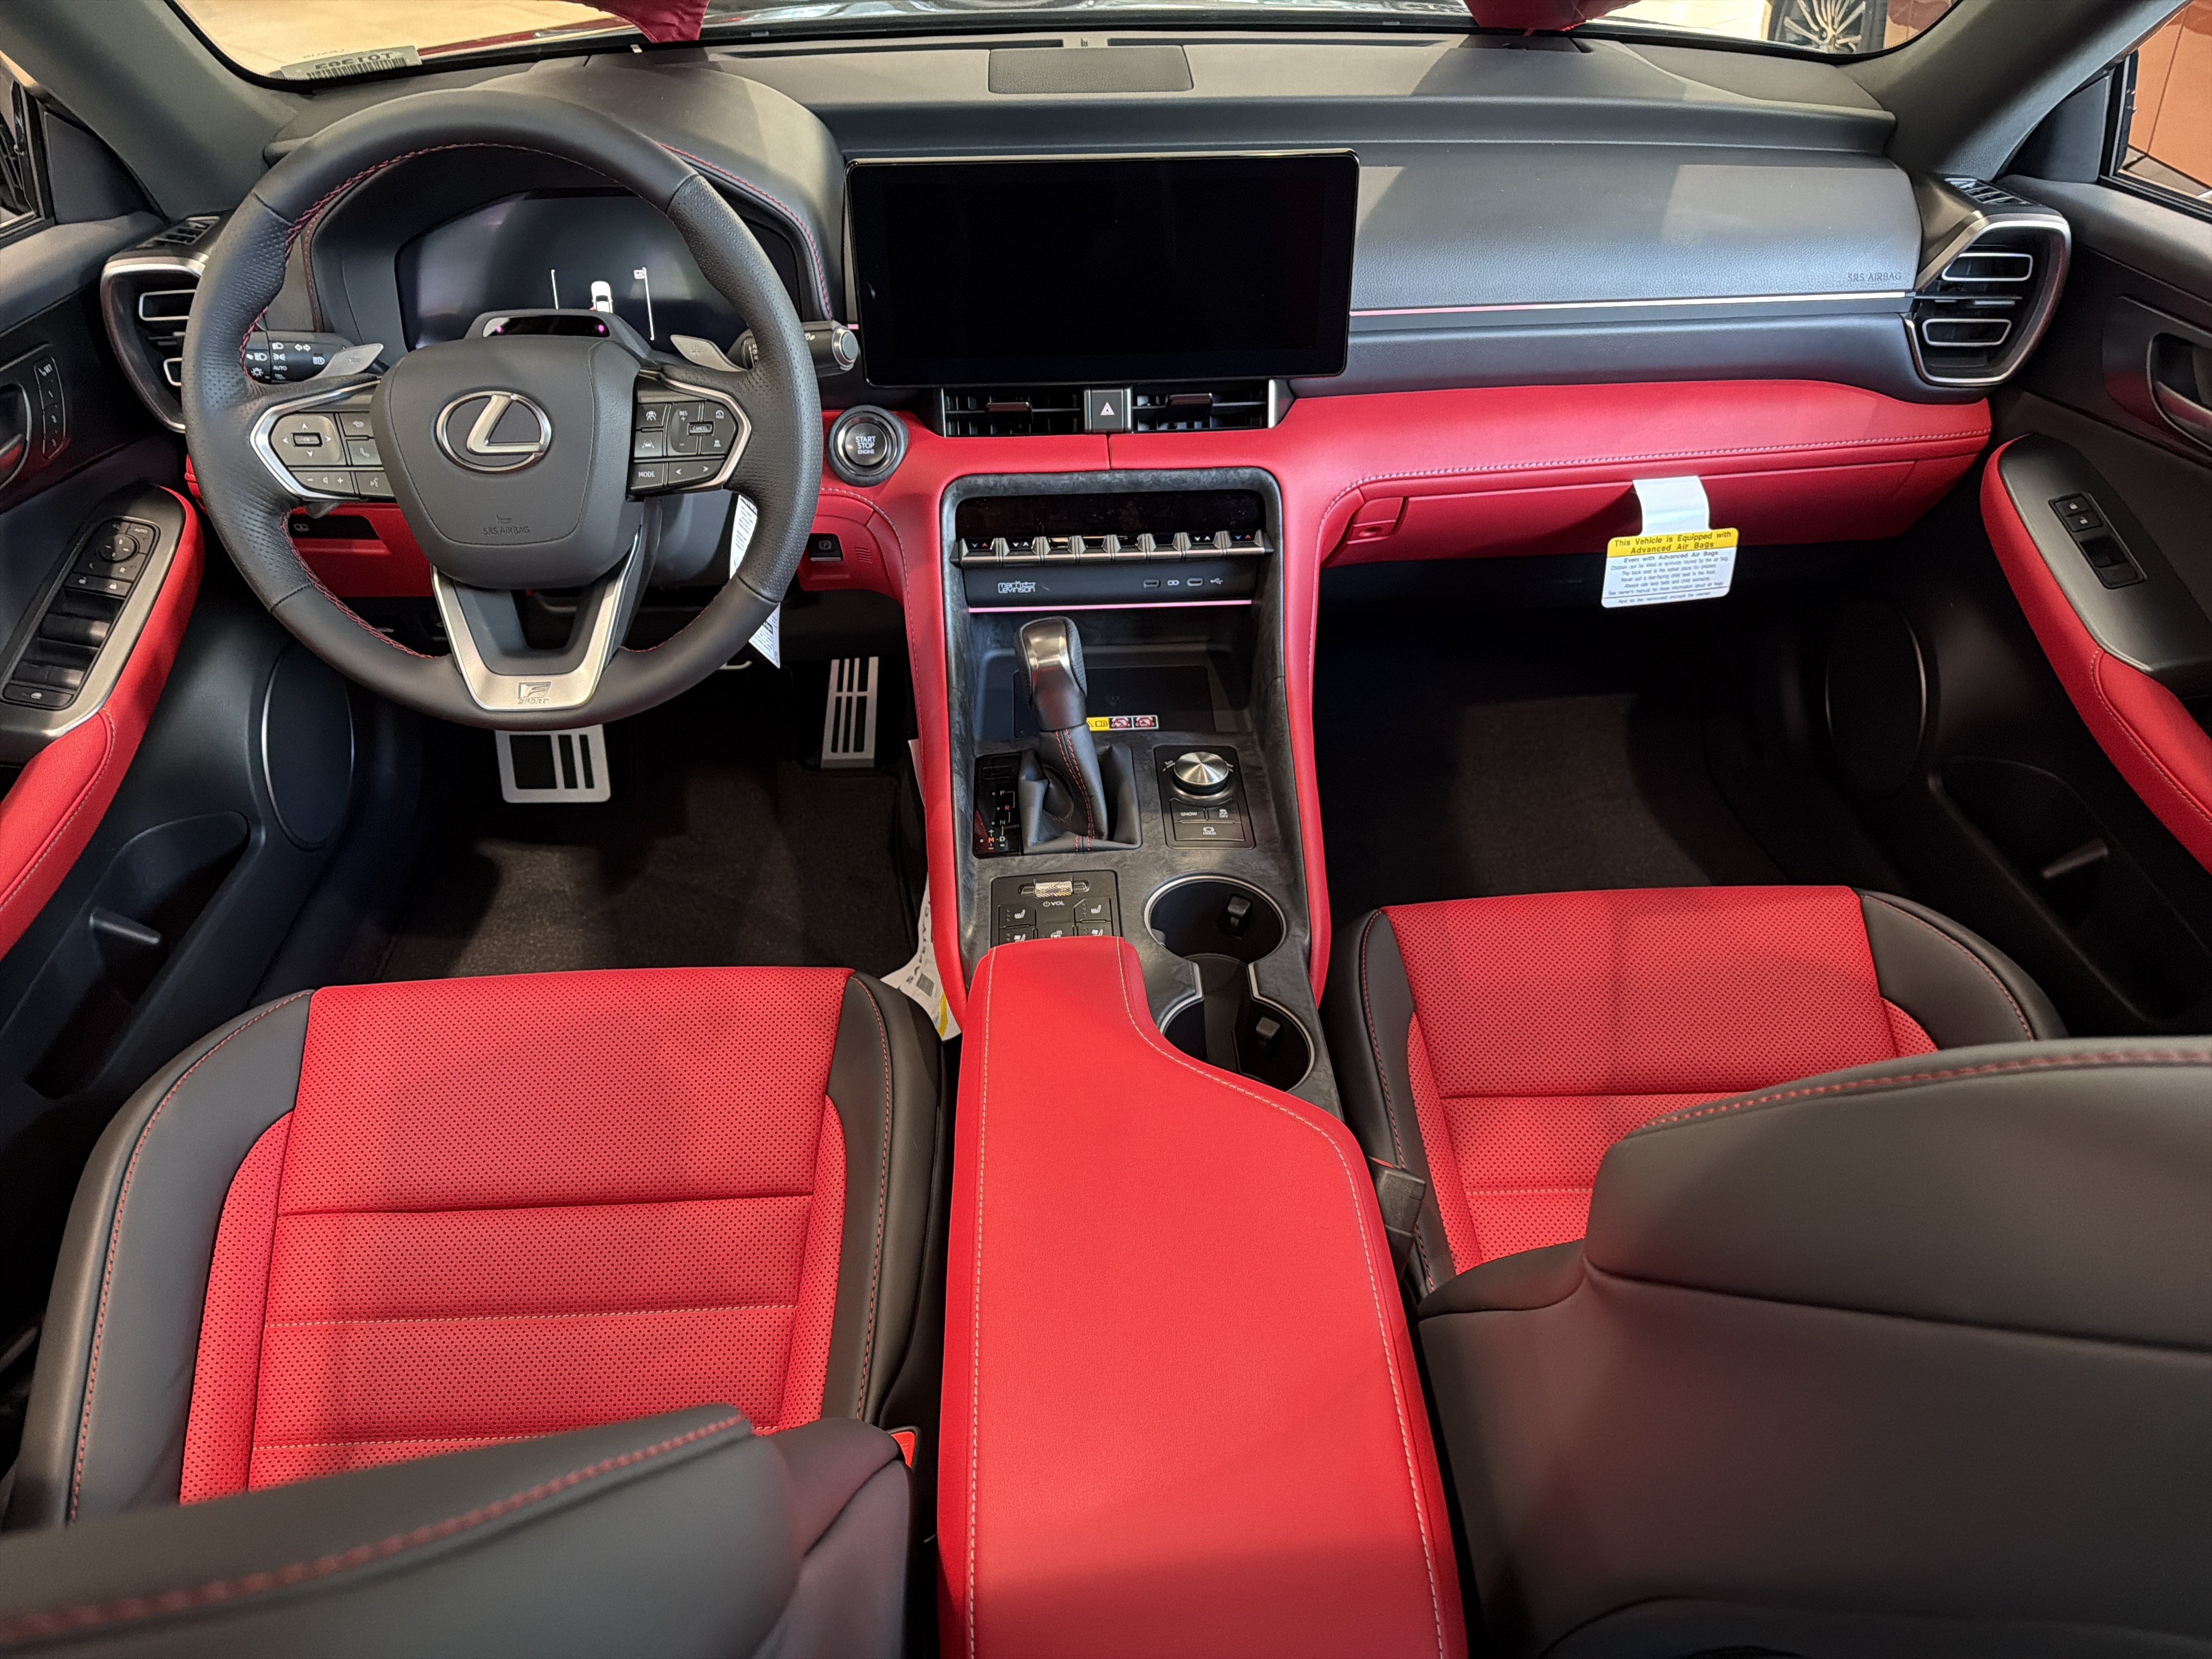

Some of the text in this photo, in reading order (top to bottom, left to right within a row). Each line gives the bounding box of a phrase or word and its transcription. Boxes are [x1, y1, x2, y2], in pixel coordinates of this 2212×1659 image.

[1847, 272, 1901, 282] SRS AIRBAG
[500, 526, 531, 534] AIRBAG
[1635, 537, 1662, 545] Vehicle
[1677, 533, 1712, 542] Equipped
[1630, 544, 1671, 554] Advanced
